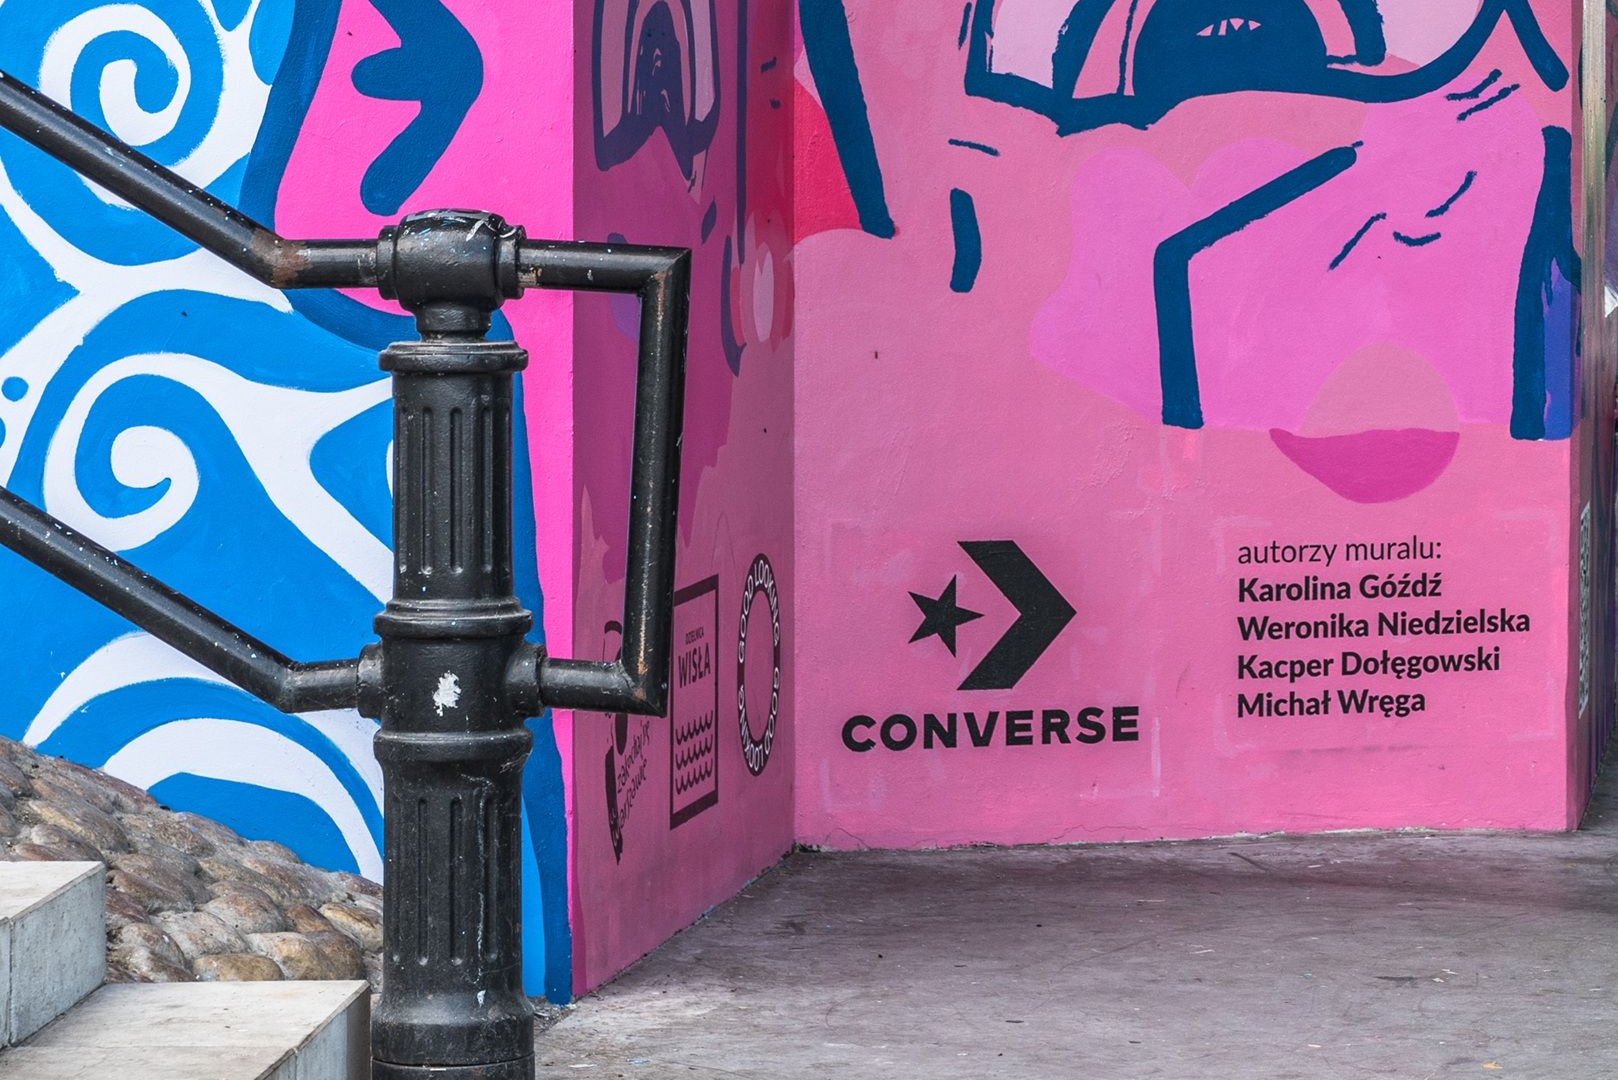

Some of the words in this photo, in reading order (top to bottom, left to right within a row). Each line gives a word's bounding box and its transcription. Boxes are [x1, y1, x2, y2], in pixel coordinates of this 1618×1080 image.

[1237, 540, 1338, 567] autorzy
[1345, 535, 1442, 561] muralu:
[1238, 575, 1351, 603] Karolina
[1358, 572, 1442, 599] Góźdź
[1237, 612, 1369, 641] Weronika
[1377, 607, 1531, 637] Niedzielska
[678, 642, 711, 688] WISŁA
[1237, 654, 1334, 684] Kacper
[1341, 646, 1500, 679] Dołęgowski
[1237, 690, 1332, 718] Michał
[1337, 688, 1426, 718] Wręga
[841, 705, 1140, 753] CONVERSE
